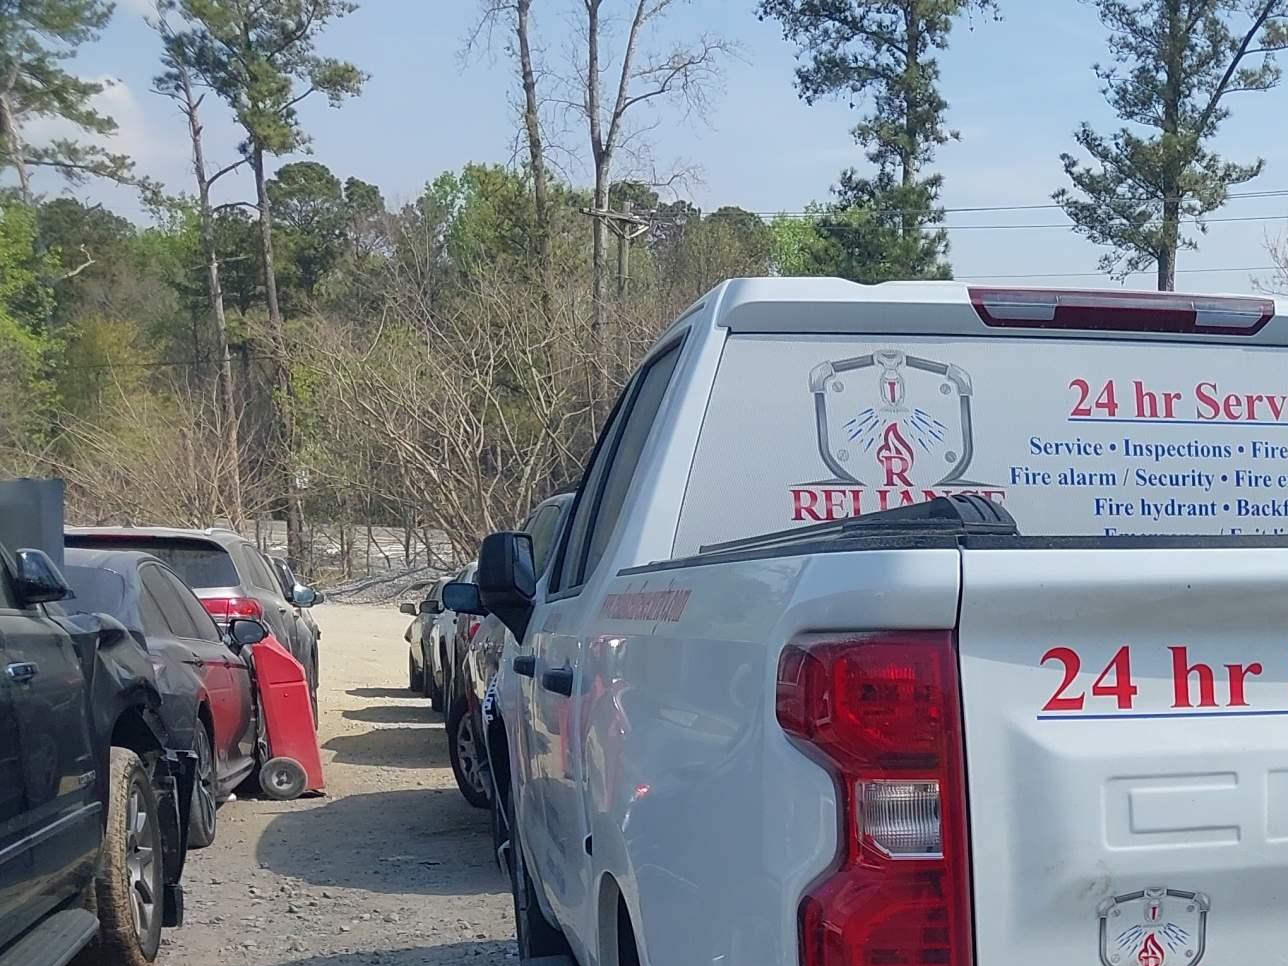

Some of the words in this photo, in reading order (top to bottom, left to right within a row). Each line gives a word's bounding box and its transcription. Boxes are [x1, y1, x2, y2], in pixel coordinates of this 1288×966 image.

[1069, 378, 1118, 417] 24
[1133, 380, 1182, 418] hr
[1029, 436, 1103, 457] Service
[1123, 439, 1232, 462] Inspections
[1010, 466, 1051, 487] Fire
[1058, 467, 1117, 488] alarm
[1135, 468, 1215, 491] Security
[1235, 469, 1274, 489] Fire
[790, 489, 1006, 521] RELI
[1094, 498, 1134, 517] Fire
[1141, 498, 1218, 523] hydrant
[1039, 645, 1137, 712] 24
[1167, 645, 1262, 708] hr
